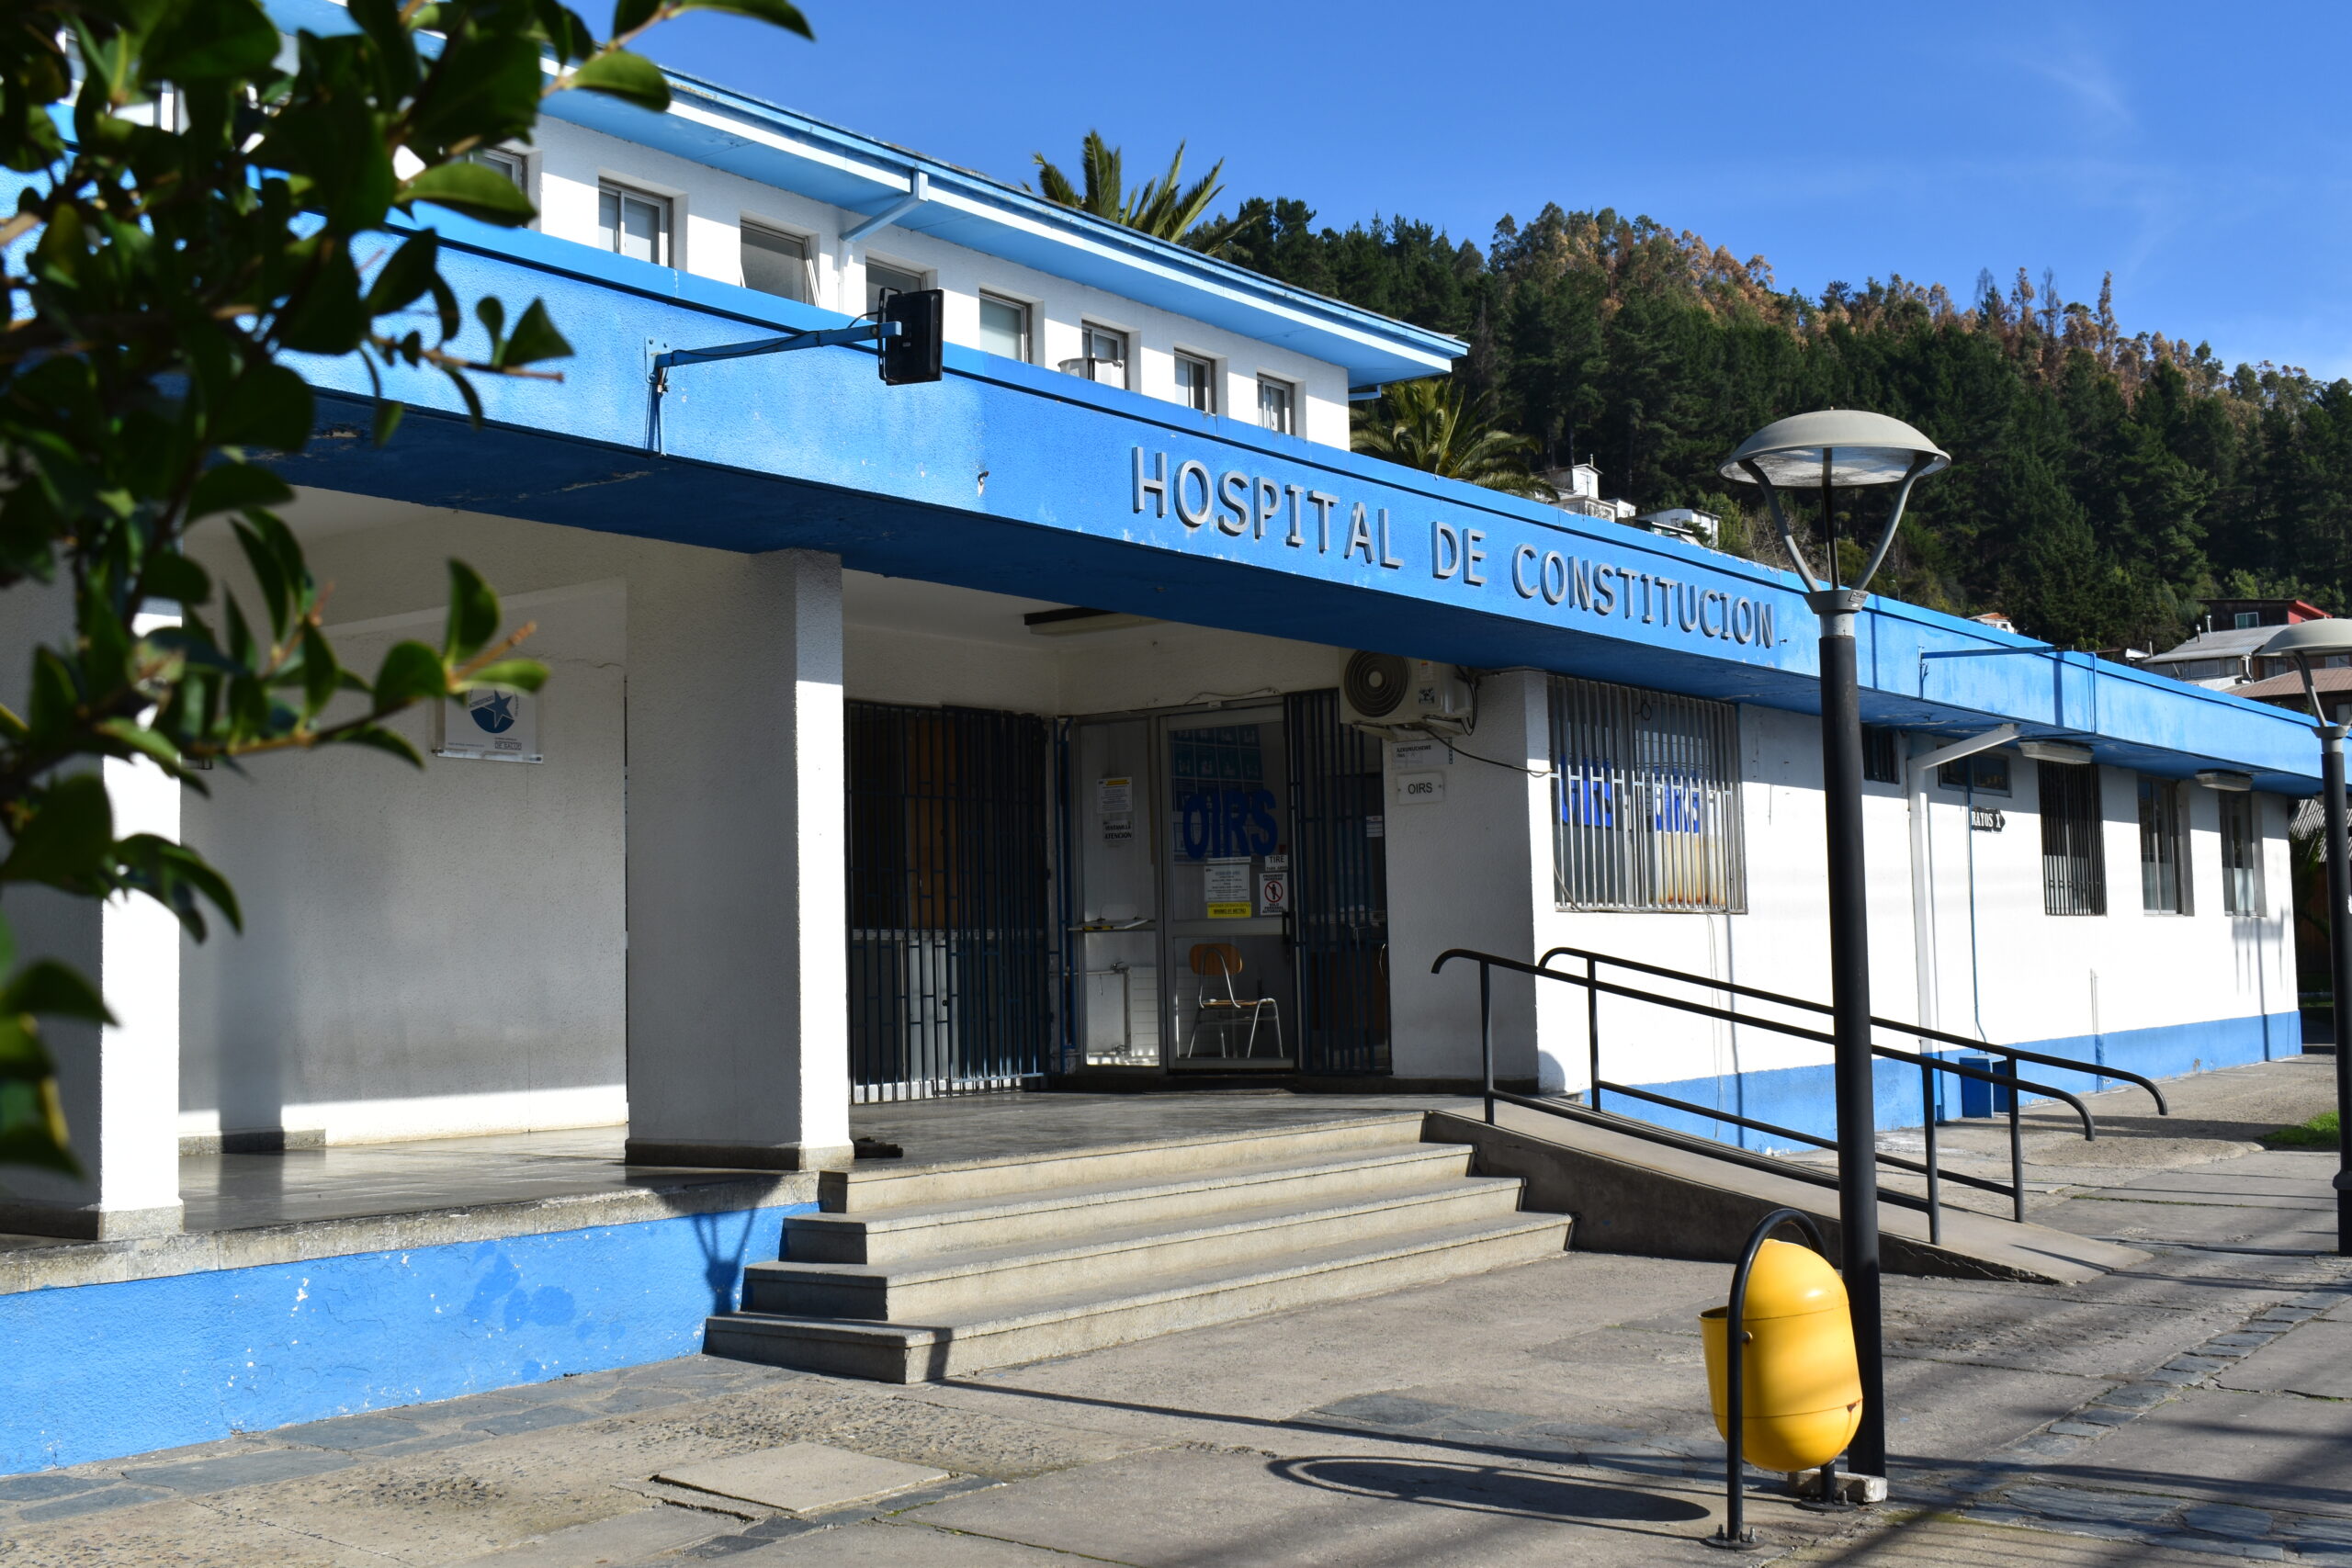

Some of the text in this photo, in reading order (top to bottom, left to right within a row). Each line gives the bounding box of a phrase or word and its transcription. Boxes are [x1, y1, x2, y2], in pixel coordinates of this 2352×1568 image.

[1132, 446, 1776, 649] HOSPITAL DE CONSTITUCION
[1408, 782, 1433, 795] OIRS
[1183, 788, 1278, 860] OIRS
[1971, 811, 2001, 829] RAYOS X
[1269, 855, 1285, 863] TIRE
